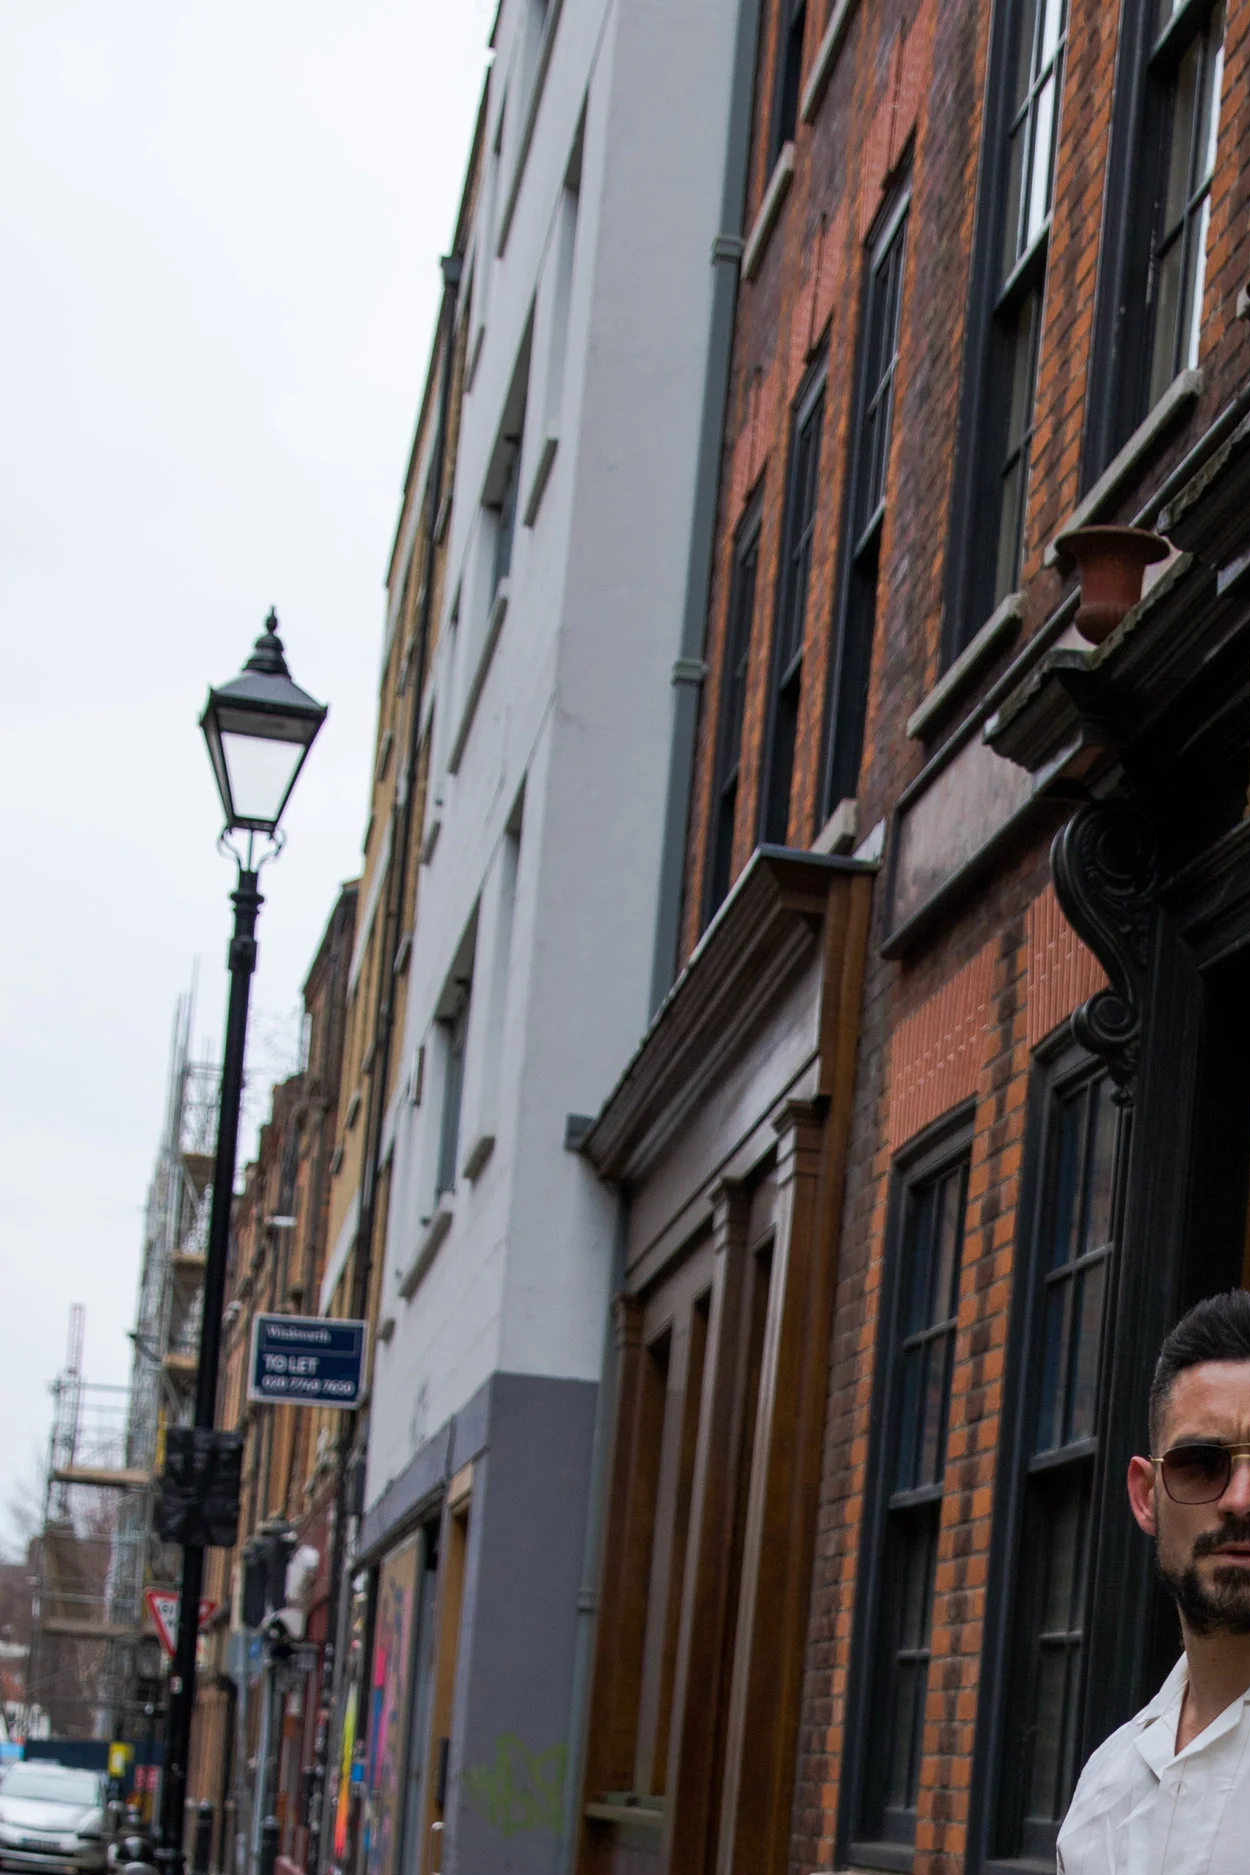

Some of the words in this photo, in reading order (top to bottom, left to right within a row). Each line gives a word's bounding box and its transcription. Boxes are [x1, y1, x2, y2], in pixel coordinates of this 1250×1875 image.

[264, 1354, 287, 1373] TO
[288, 1356, 319, 1375] LET
[262, 1375, 287, 1391] 020
